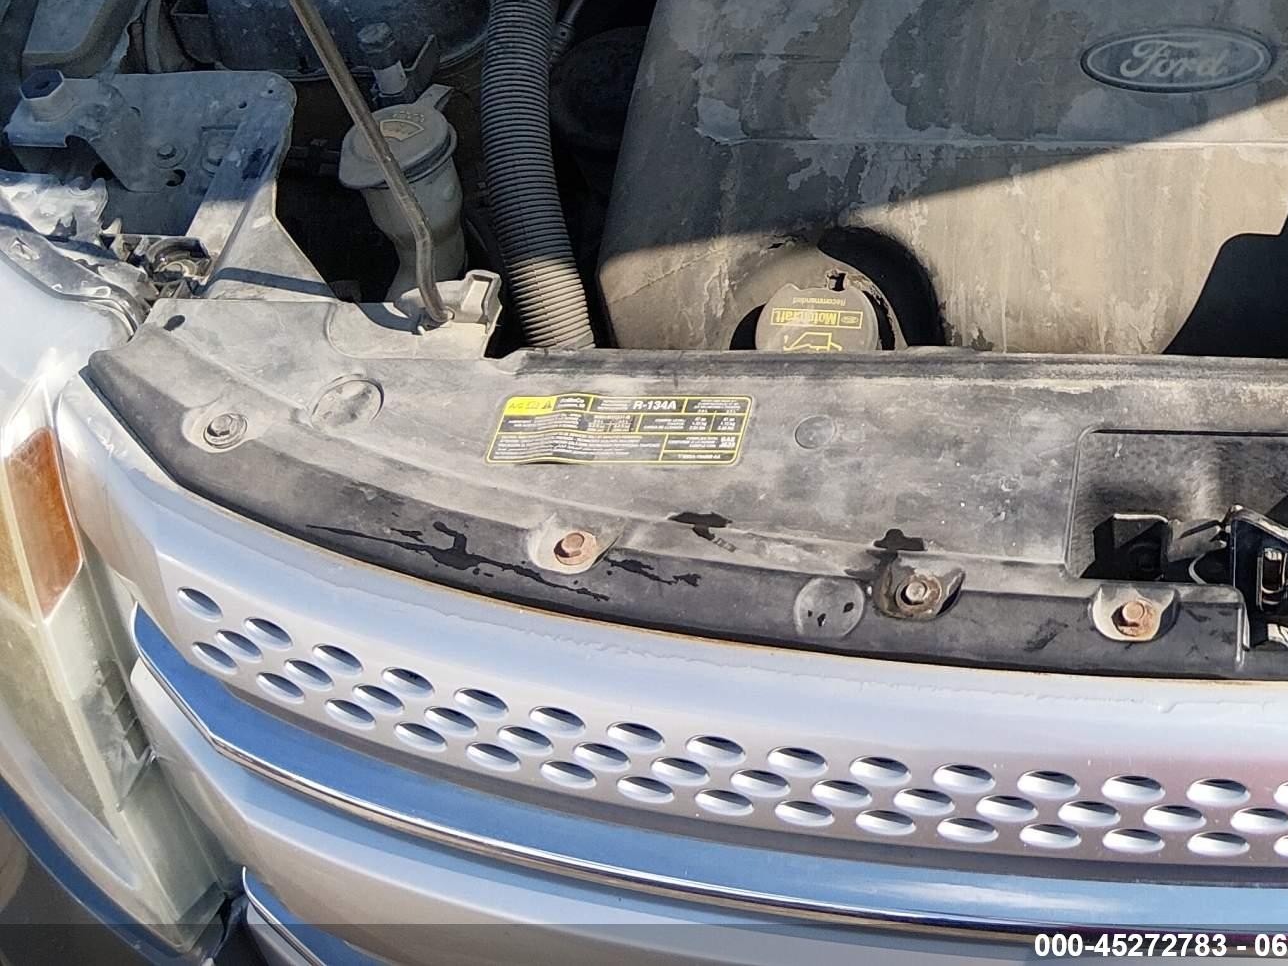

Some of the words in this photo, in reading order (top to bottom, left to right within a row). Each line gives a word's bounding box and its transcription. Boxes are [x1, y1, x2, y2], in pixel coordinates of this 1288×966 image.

[1119, 39, 1230, 78] Ford
[775, 310, 838, 325] Motorcraft
[632, 400, 676, 411] R-134A
